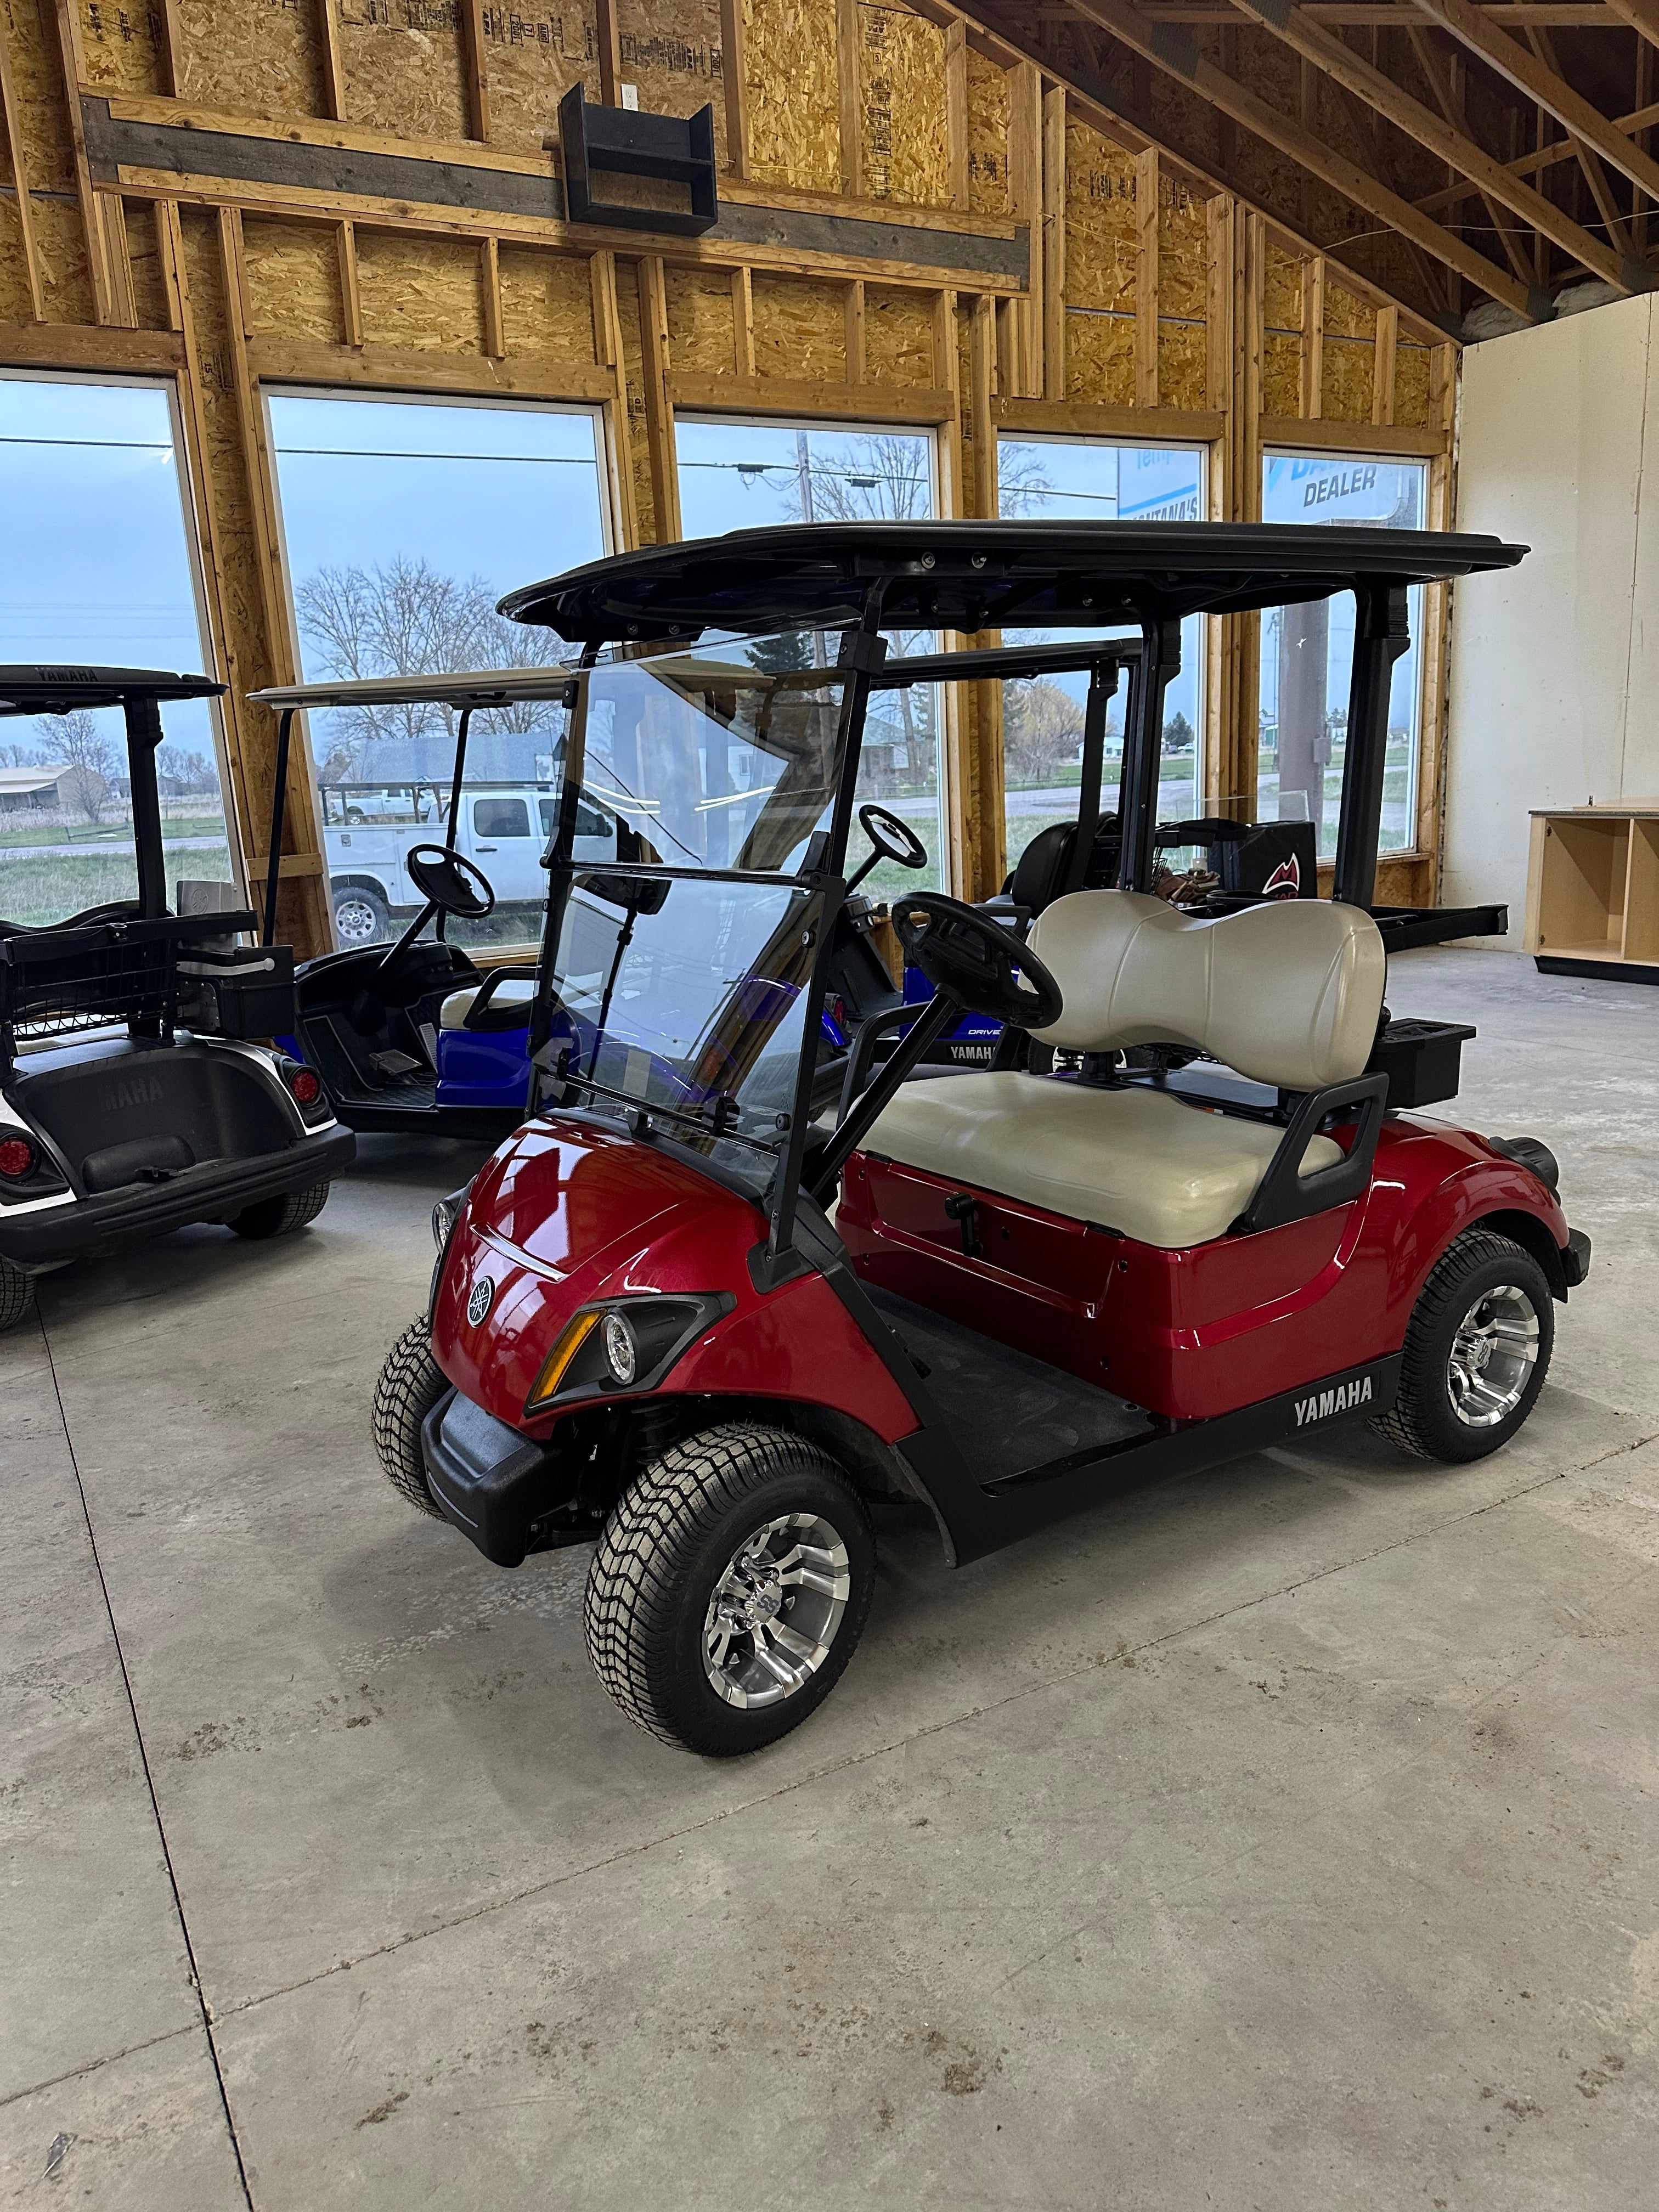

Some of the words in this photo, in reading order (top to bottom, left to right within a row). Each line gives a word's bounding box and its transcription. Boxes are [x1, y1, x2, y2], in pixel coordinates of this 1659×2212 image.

[512, 21, 521, 40] 2001
[1304, 465, 1377, 507] DEALER
[35, 667, 99, 681] YAMAHA
[951, 1046, 996, 1060] YAMAH
[1294, 1376, 1372, 1427] YAMAHA
[757, 1594, 779, 1613] SS
